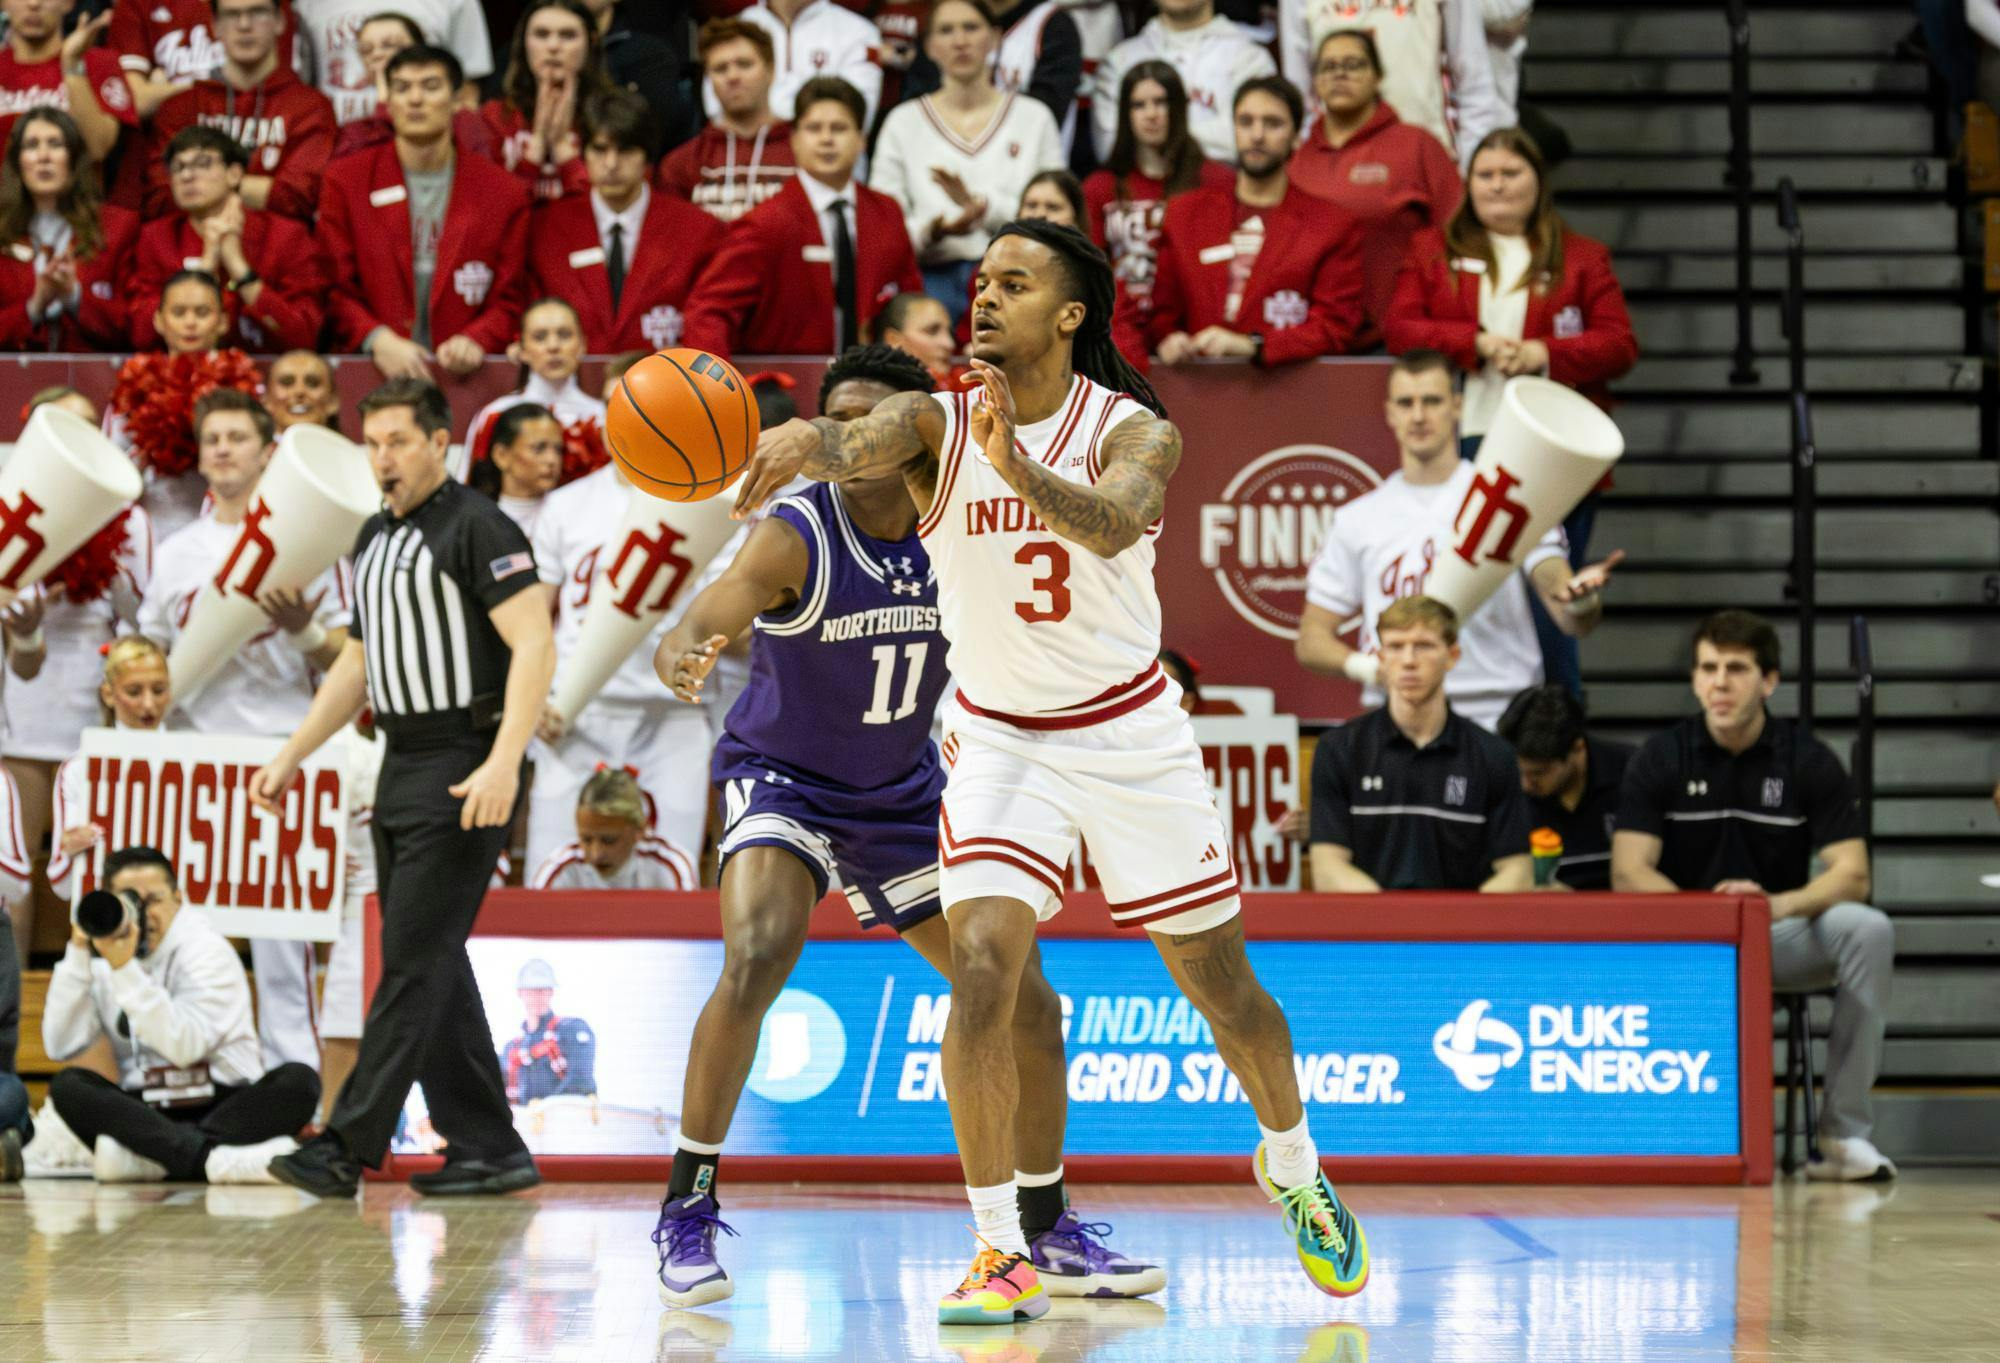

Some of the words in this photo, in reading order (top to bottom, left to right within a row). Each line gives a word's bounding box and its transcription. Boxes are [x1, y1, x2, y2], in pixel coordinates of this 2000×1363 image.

[1947, 362, 1963, 391] 7
[1014, 541, 1072, 624] 3
[862, 642, 928, 724] 11
[81, 757, 340, 912] HOOSIERS
[1529, 1004, 1650, 1048] DUKE
[1066, 1051, 1172, 1103] GRID
